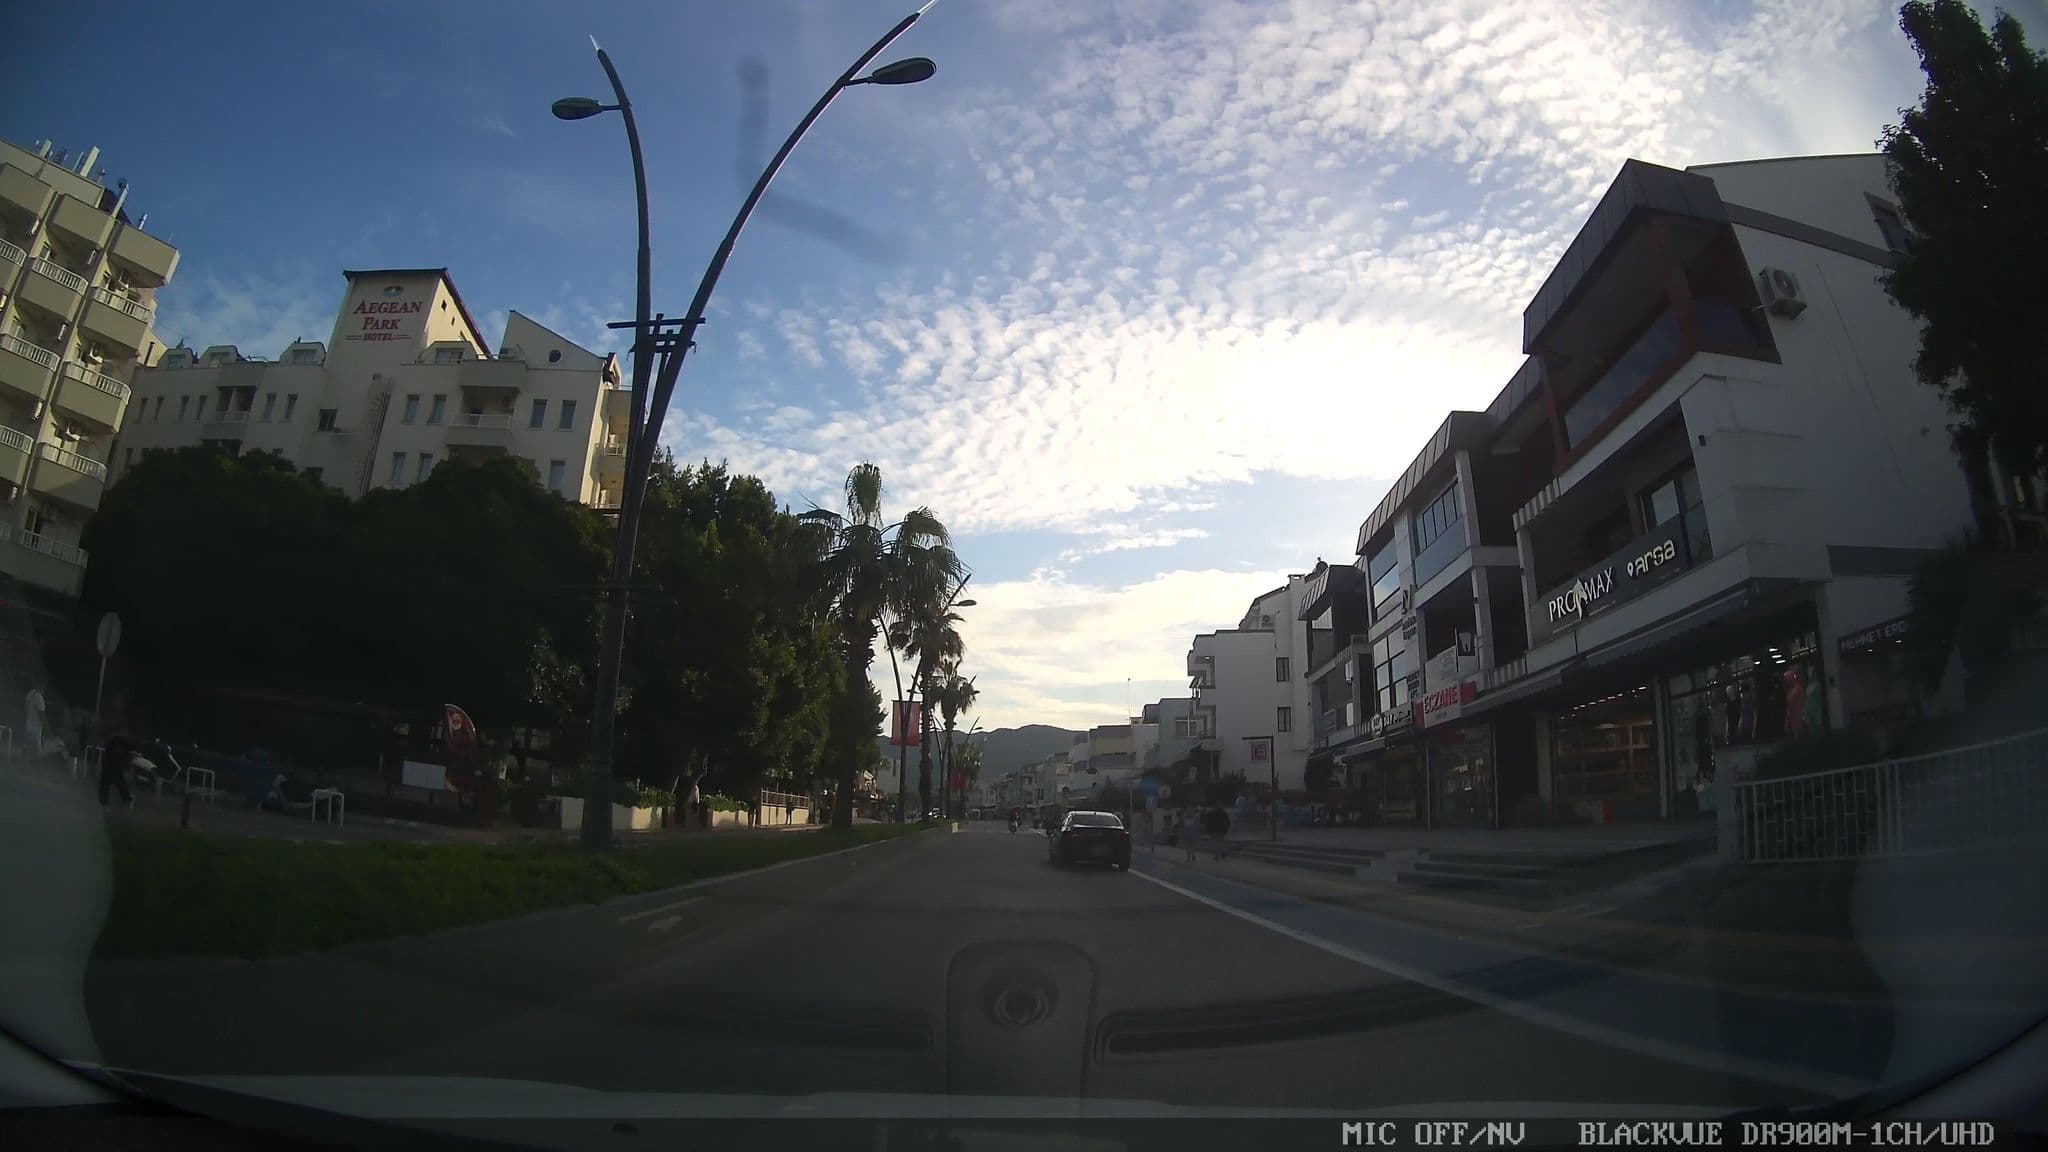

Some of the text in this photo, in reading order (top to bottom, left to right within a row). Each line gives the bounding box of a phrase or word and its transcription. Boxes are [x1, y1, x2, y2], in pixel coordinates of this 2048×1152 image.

[354, 300, 422, 314] AEGEAN
[361, 317, 401, 330] PARK
[363, 332, 394, 341] HOTEL
[1635, 539, 1676, 576] arsa
[1841, 630, 1882, 651] MEHMET
[1424, 687, 1458, 714] ECZANE
